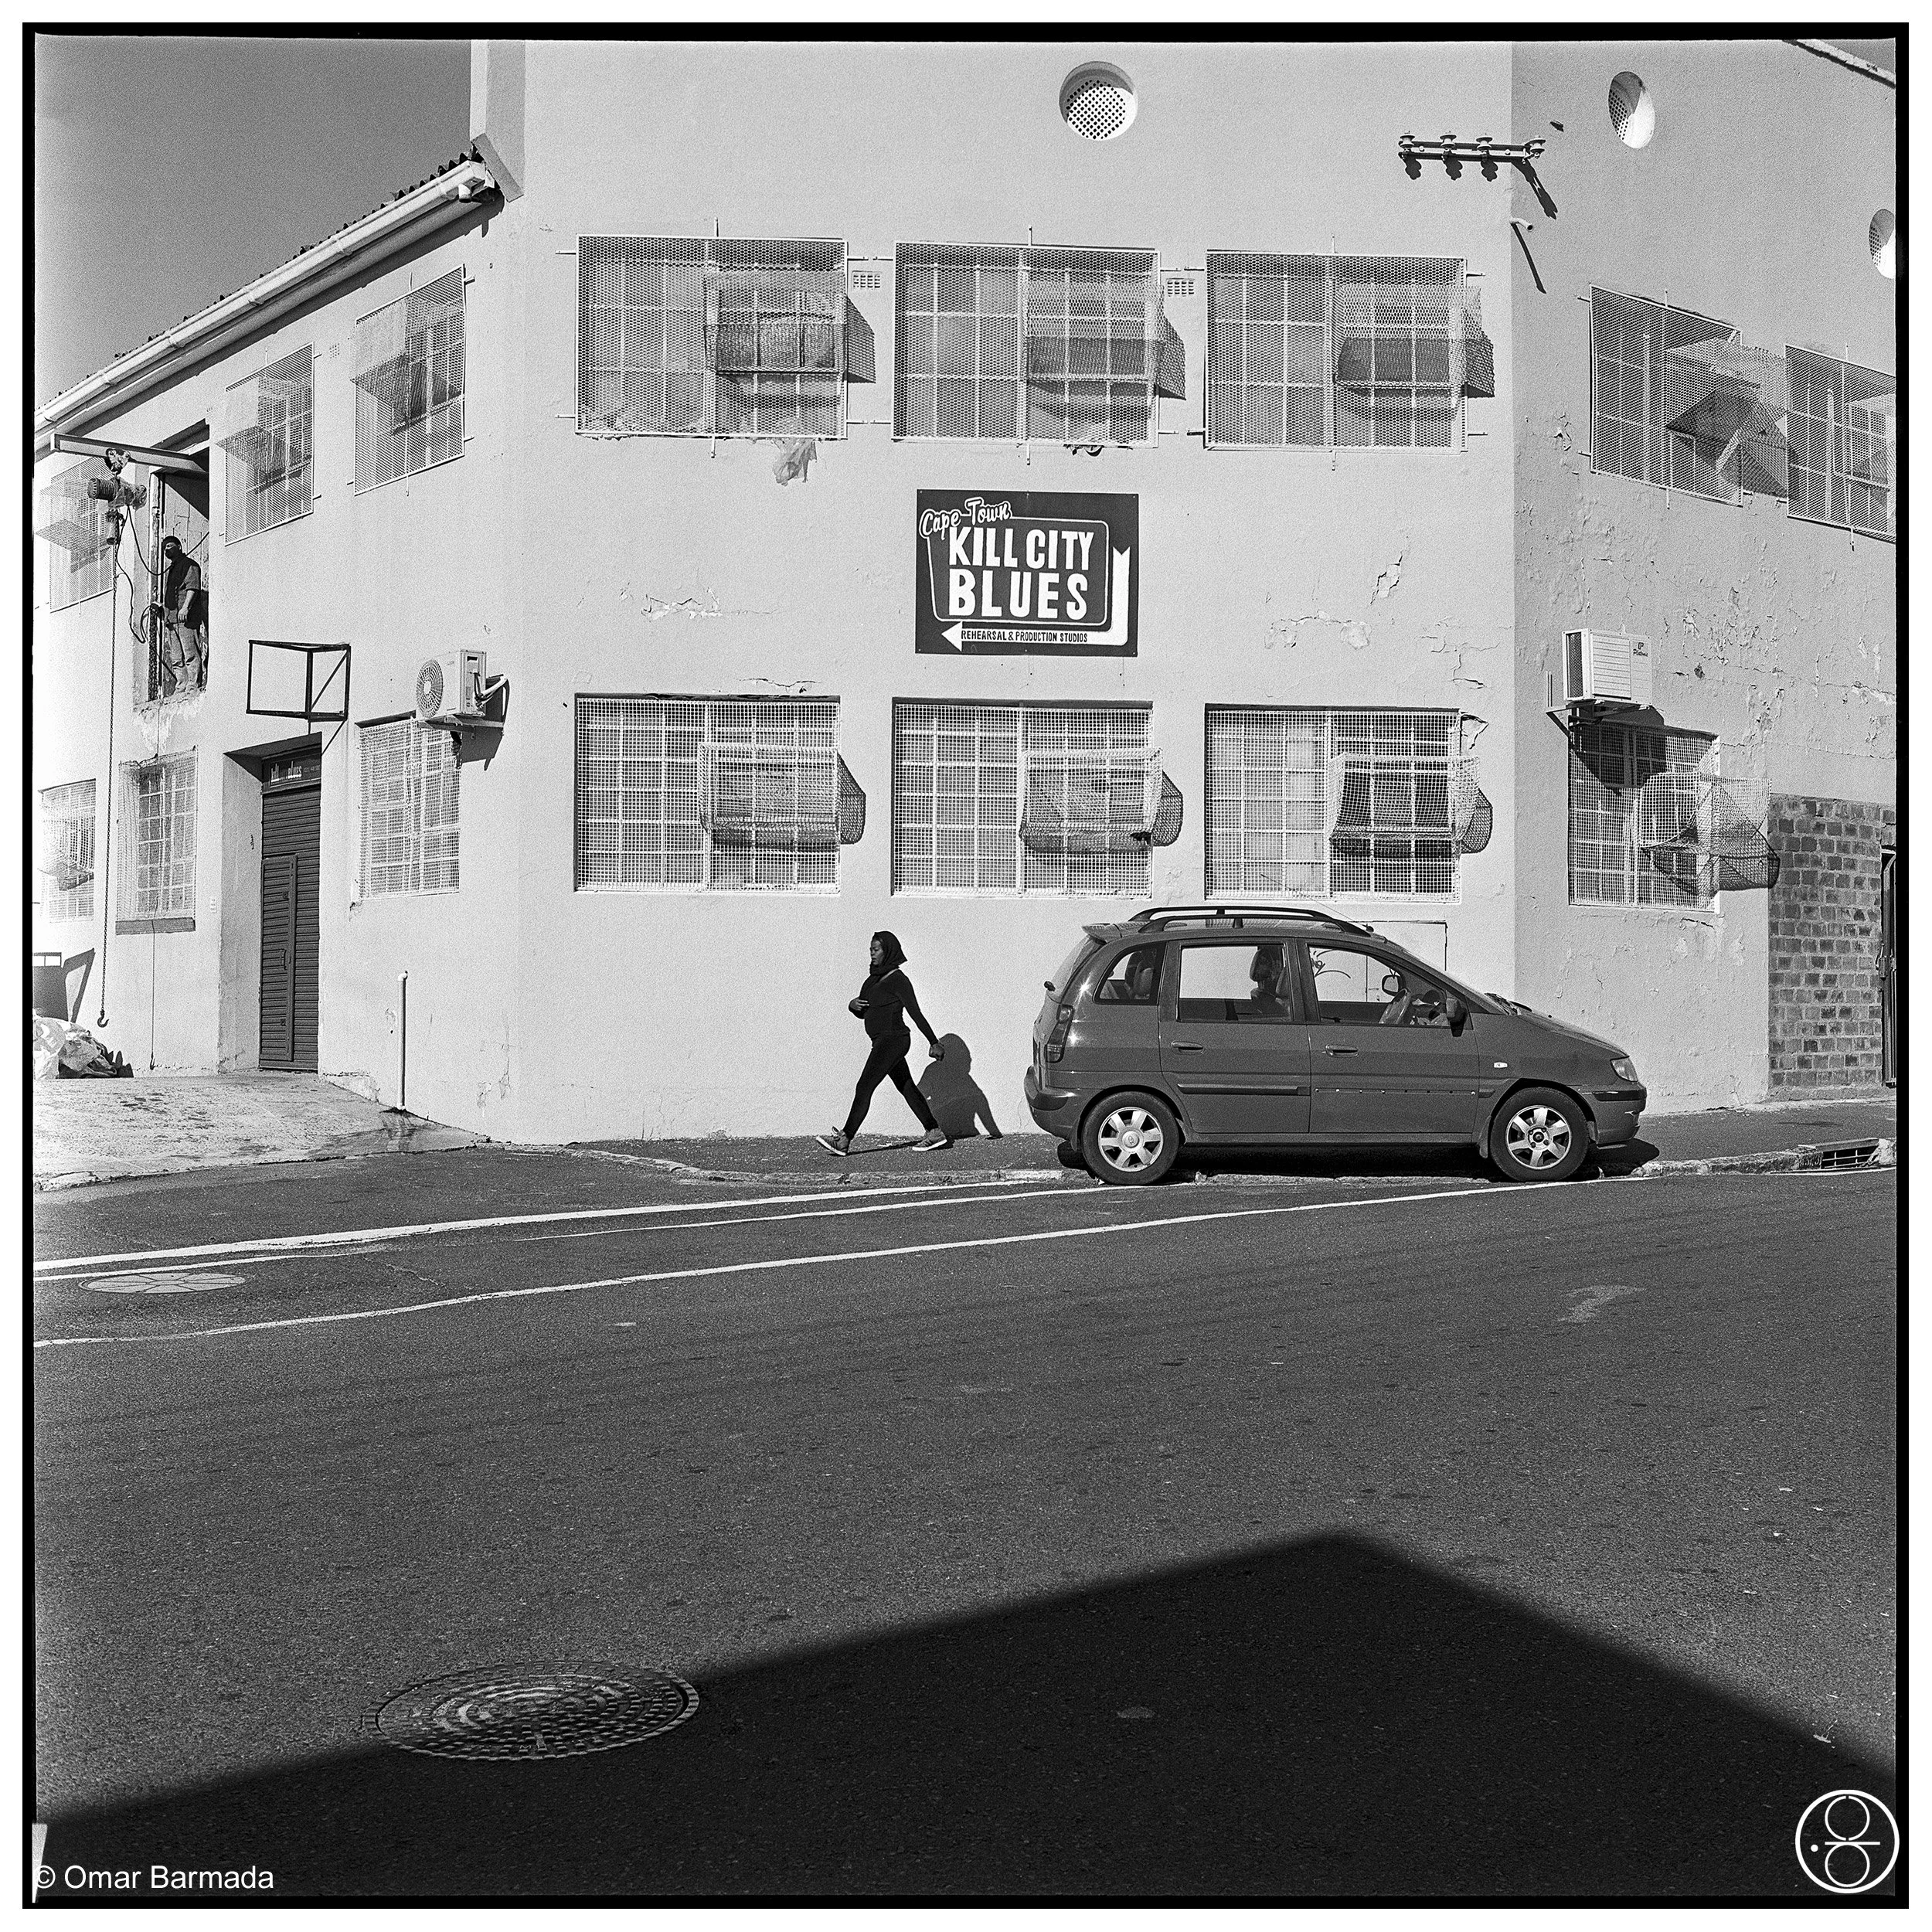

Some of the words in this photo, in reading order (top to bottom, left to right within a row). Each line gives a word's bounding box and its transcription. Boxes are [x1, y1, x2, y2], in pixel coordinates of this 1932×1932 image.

[922, 512, 961, 541] Cape
[968, 500, 1010, 526] Town
[949, 526, 1018, 568] KILL
[1026, 529, 1094, 570] CITY
[949, 568, 1088, 621] BLUES
[961, 630, 1007, 641] REHEARSAL
[1015, 631, 1057, 642] PRODUCTION
[1060, 632, 1088, 643] STUDIOS
